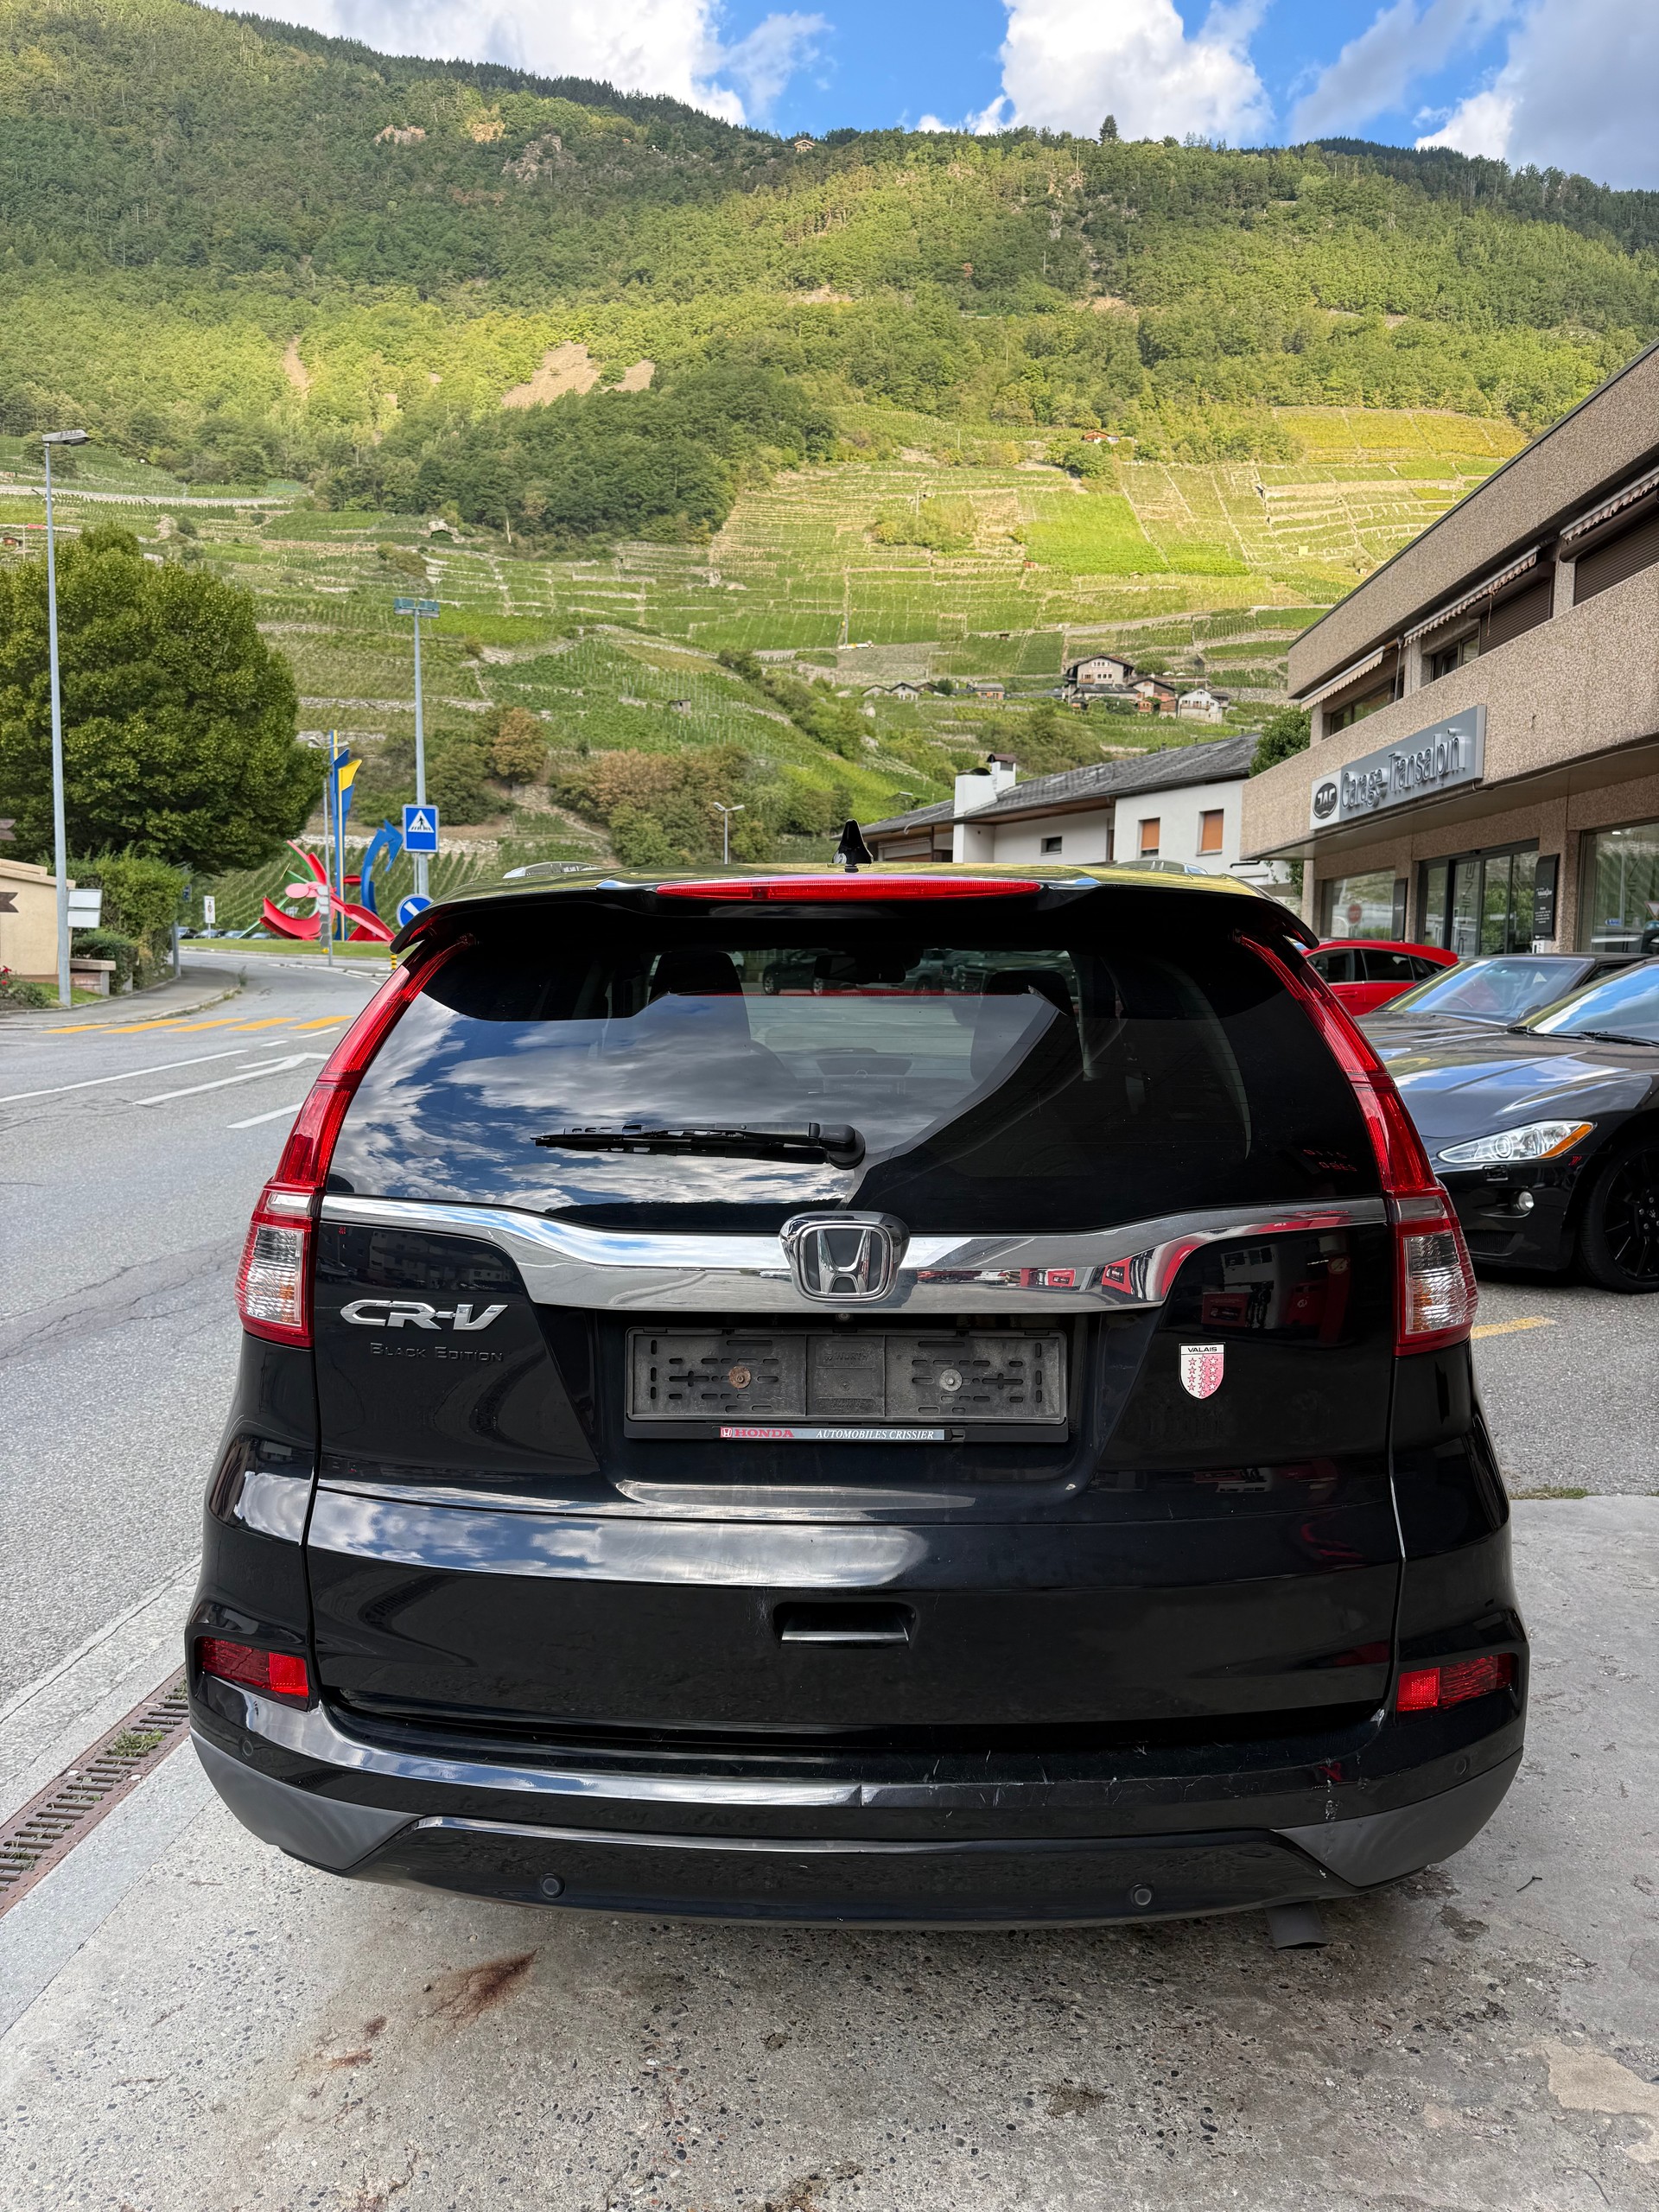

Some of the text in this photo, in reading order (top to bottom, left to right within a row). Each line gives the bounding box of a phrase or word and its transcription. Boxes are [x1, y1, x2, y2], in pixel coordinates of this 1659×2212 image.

[1341, 728, 1467, 809] Garage Transalpin
[340, 1299, 509, 1331] CR-V
[734, 1428, 795, 1438] HONDA
[816, 1429, 887, 1440] AUTOMOBILES
[888, 1430, 934, 1440] CRISSIER
